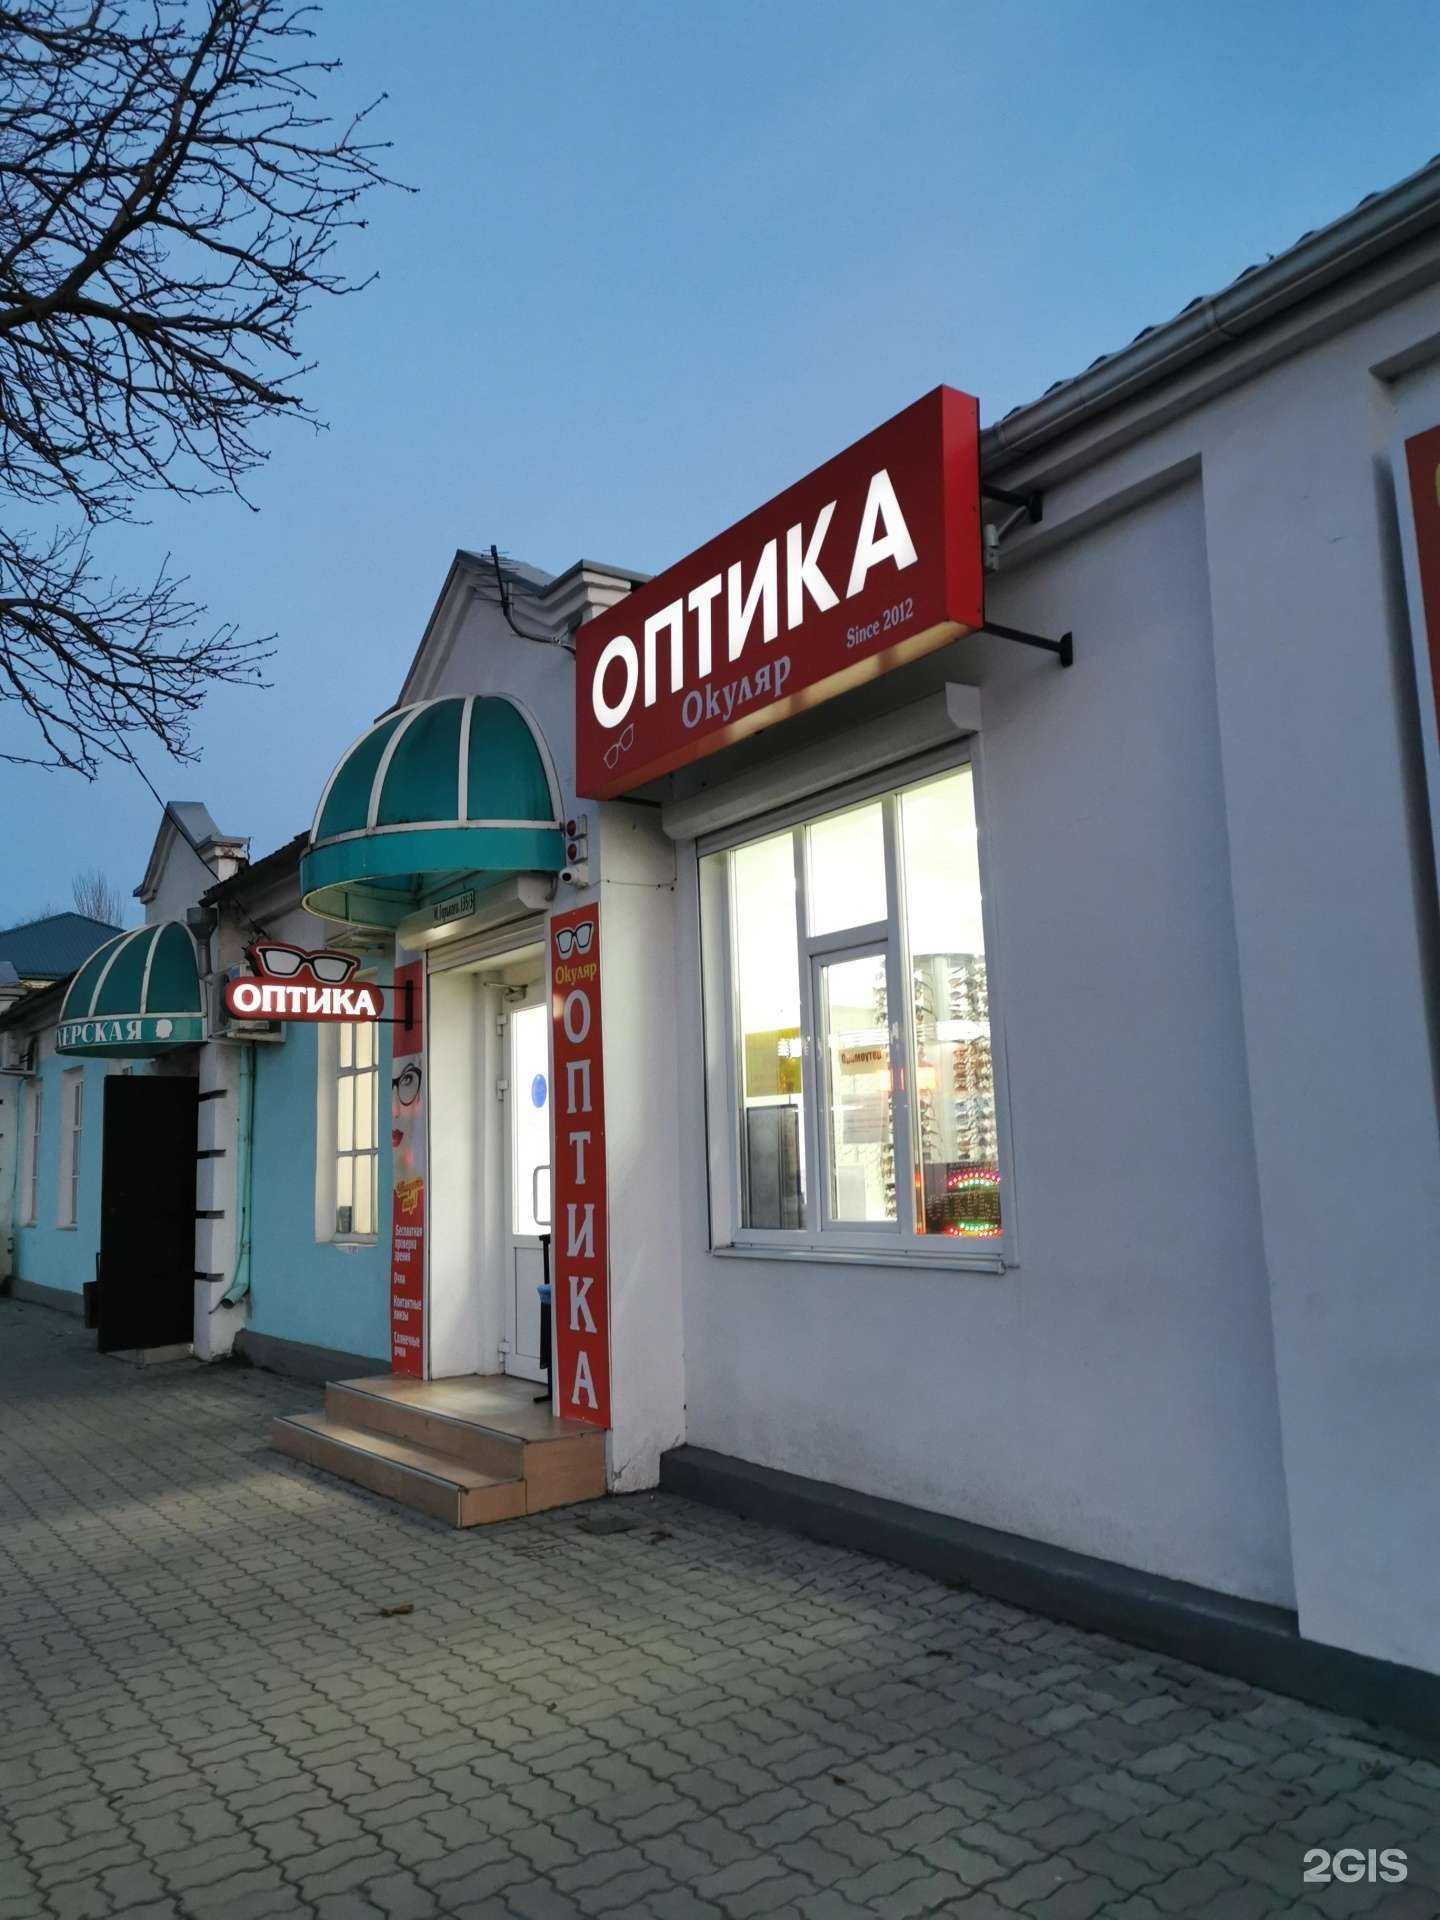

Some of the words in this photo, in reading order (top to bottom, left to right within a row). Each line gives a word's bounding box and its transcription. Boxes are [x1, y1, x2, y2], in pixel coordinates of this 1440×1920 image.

[592, 469, 918, 728] ОПТИКА
[846, 617, 880, 648] Since
[883, 597, 914, 630] 2012
[682, 655, 791, 729] Окуляр
[233, 983, 377, 1016] ОПТИКА
[556, 963, 597, 986] Окуляр
[562, 990, 599, 1410] ОПТИКА
